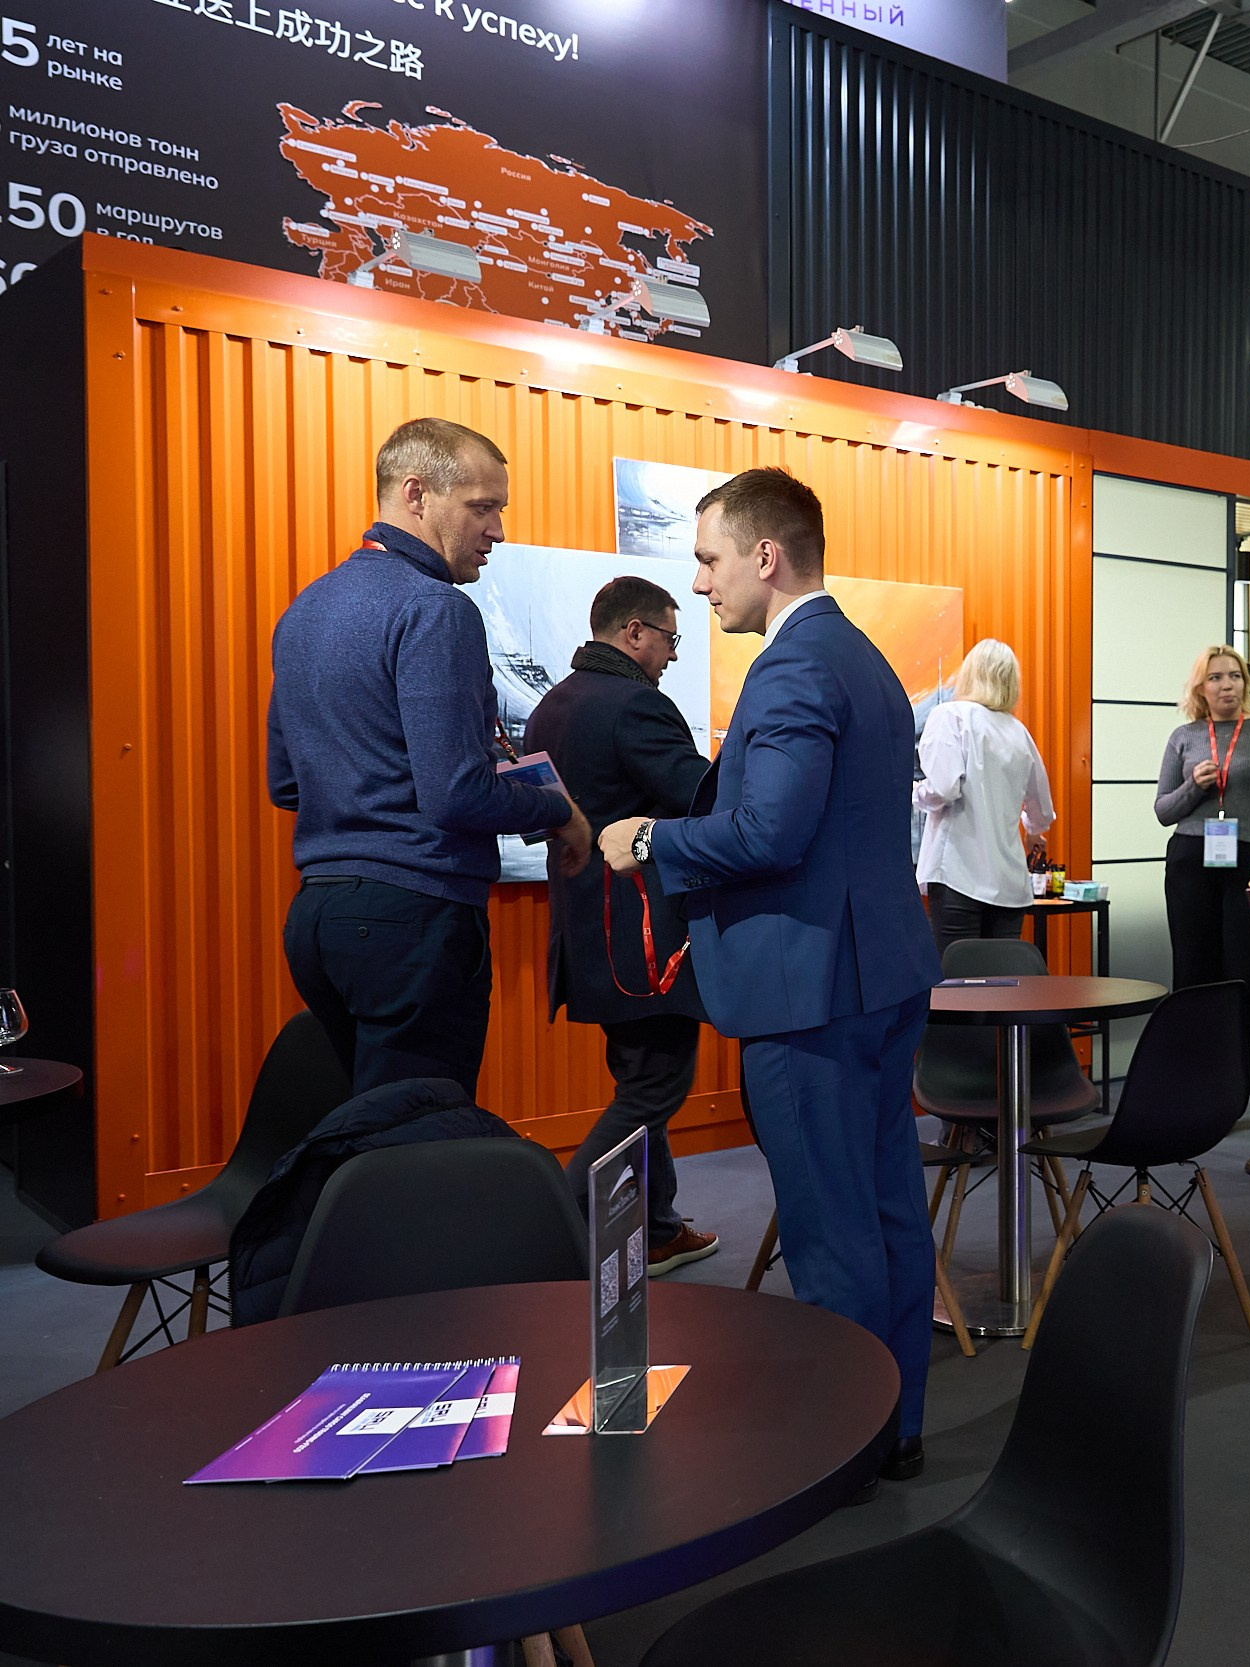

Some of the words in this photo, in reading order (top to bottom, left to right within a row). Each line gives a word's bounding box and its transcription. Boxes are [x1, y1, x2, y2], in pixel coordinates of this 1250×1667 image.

[788, 0, 904, 26] ЕННЫЙ
[153, 0, 425, 80] 送上成功之路
[461, 3, 579, 61] успеху!
[47, 34, 88, 56] лет
[94, 46, 123, 66] на
[47, 59, 123, 91] рынке
[9, 104, 142, 148] миллионов
[147, 137, 199, 162] тонн
[9, 130, 77, 160] груза
[84, 147, 219, 190] отправлено
[501, 167, 532, 181] Россия
[0, 181, 86, 238] 50
[96, 202, 223, 240] маршрутов
[393, 210, 443, 229] Казахстан
[302, 234, 337, 248] Турция
[528, 255, 570, 272] Монголия
[385, 277, 411, 290] Иран
[528, 281, 554, 293] Китай
